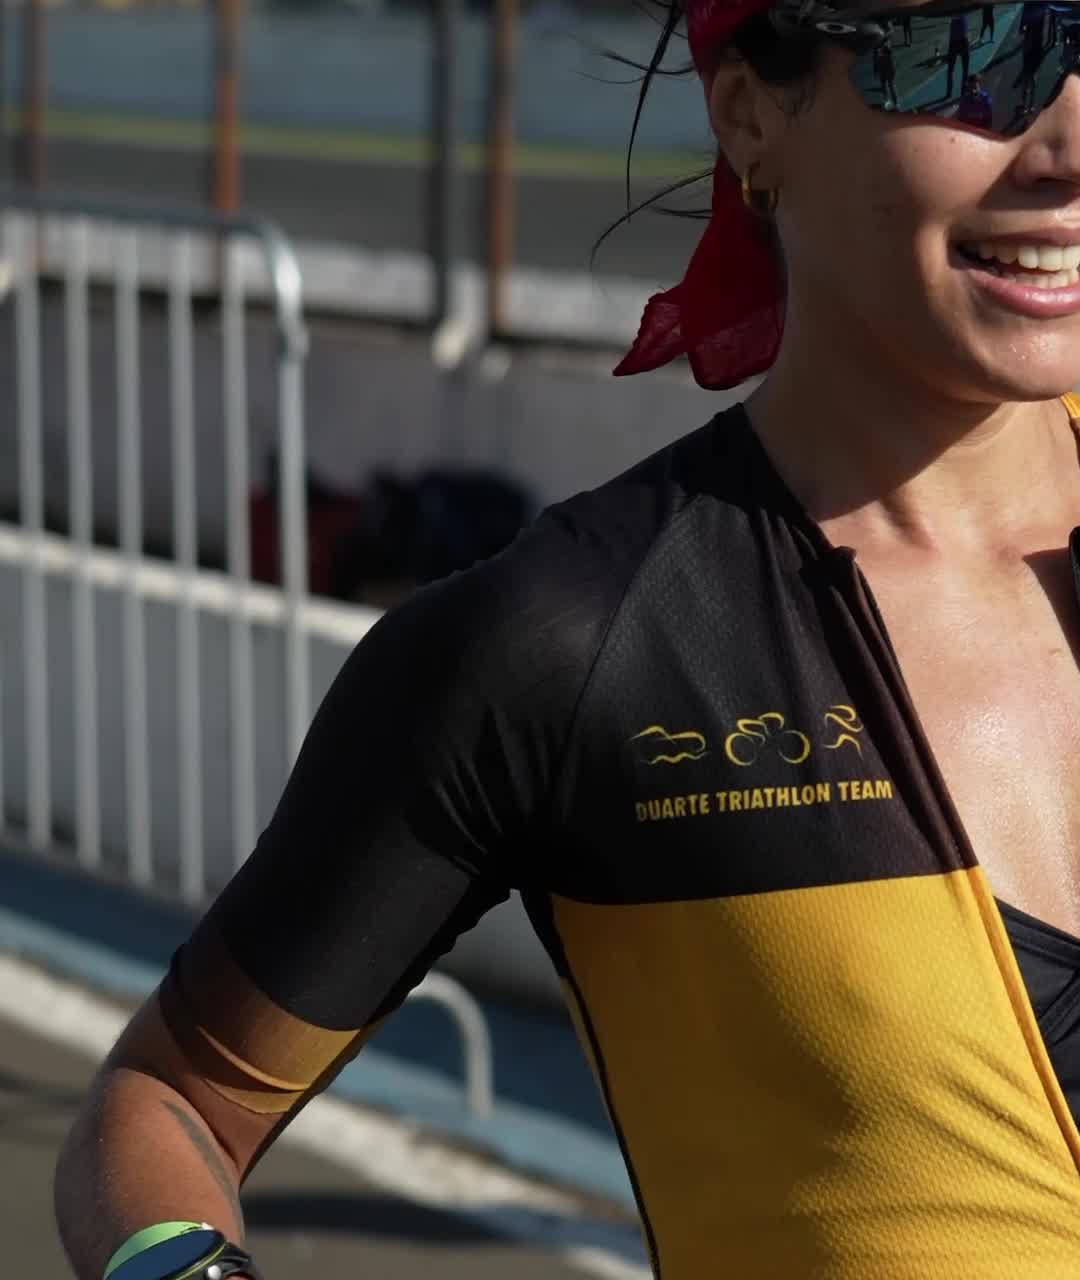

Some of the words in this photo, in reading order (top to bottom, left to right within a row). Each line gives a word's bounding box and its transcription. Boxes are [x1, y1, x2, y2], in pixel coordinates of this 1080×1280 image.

[636, 792, 710, 821] DUARTE
[716, 782, 831, 813] TRIATHLON
[838, 779, 893, 802] TEAM
